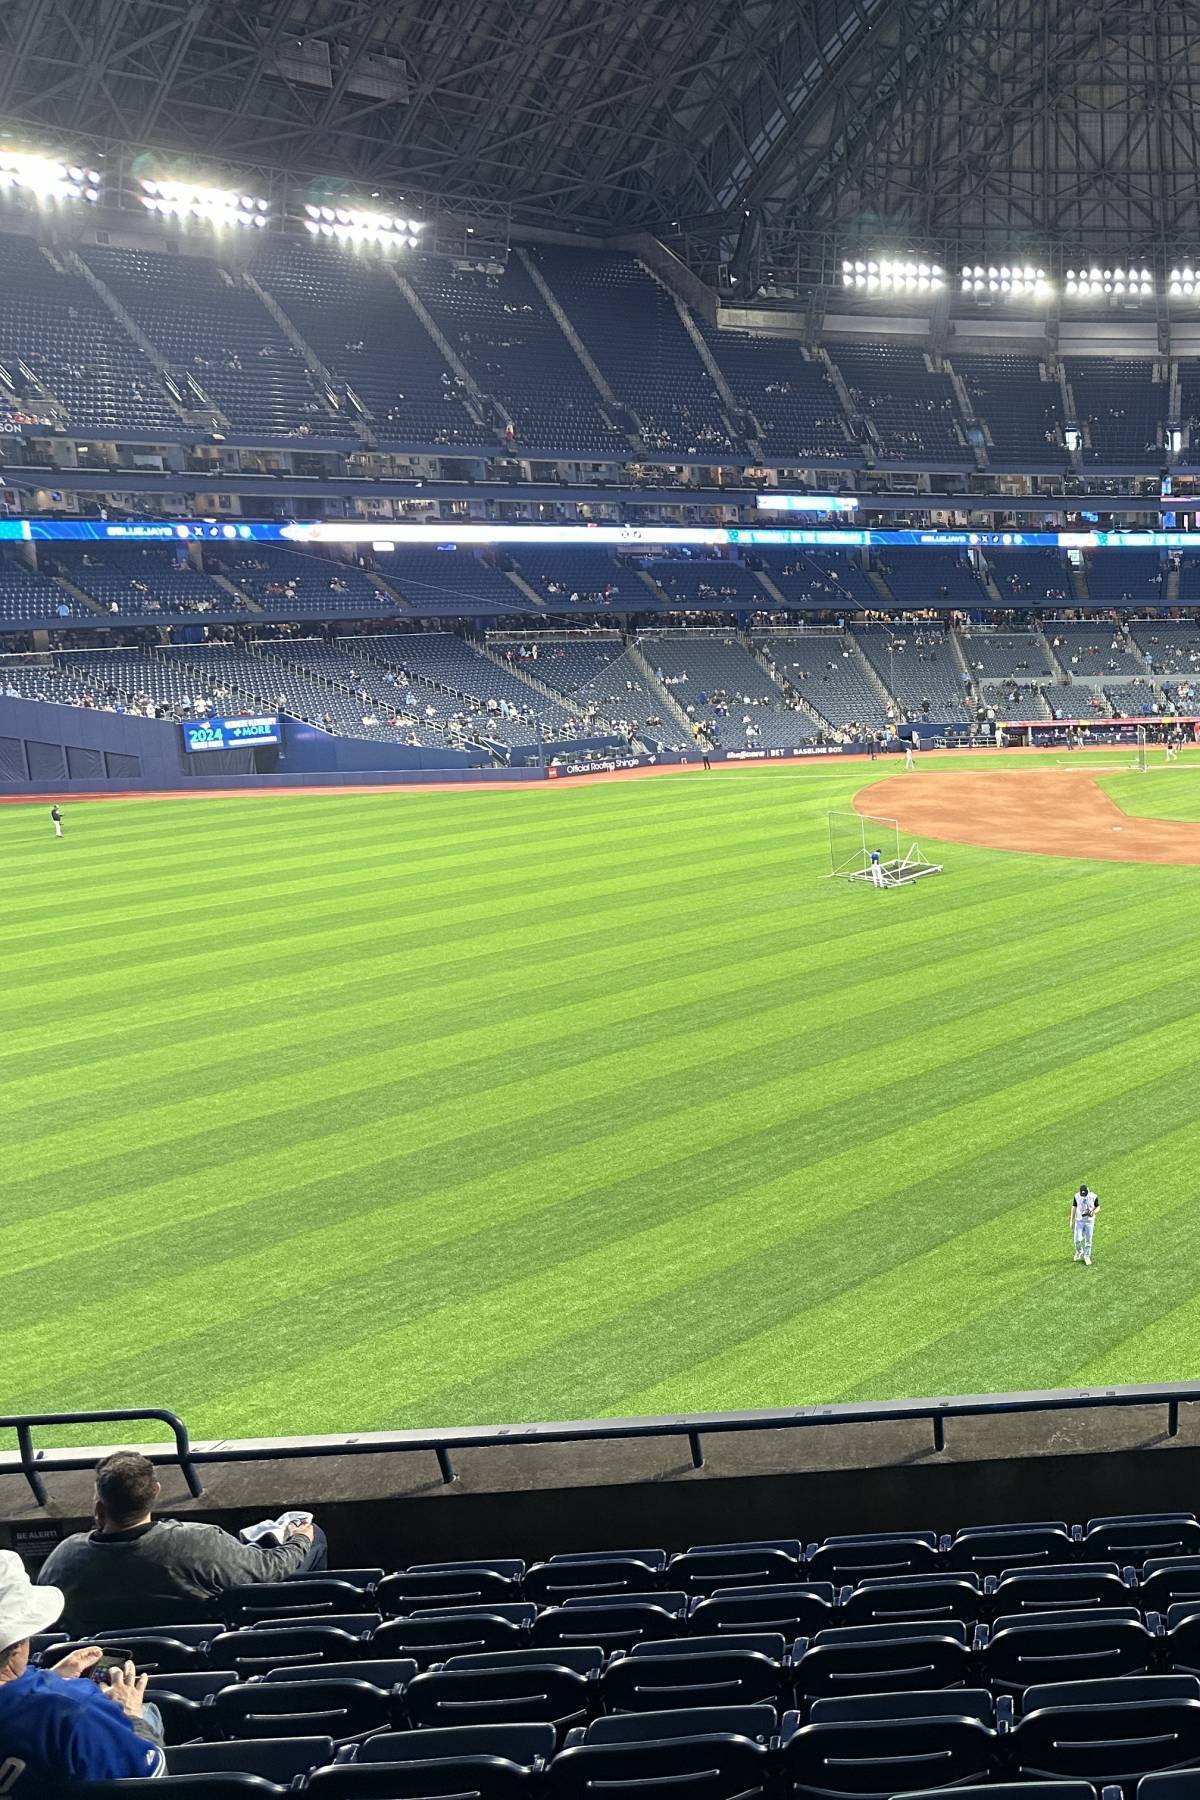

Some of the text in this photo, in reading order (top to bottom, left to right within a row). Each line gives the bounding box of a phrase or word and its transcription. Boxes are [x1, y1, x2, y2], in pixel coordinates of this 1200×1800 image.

[189, 728, 223, 742] 2024
[770, 749, 785, 757] BET
[793, 747, 827, 755] BASELINE
[828, 746, 843, 754] BOX
[566, 763, 590, 774] Official
[616, 758, 640, 768] Shingle
[16, 1531, 28, 1540] BE
